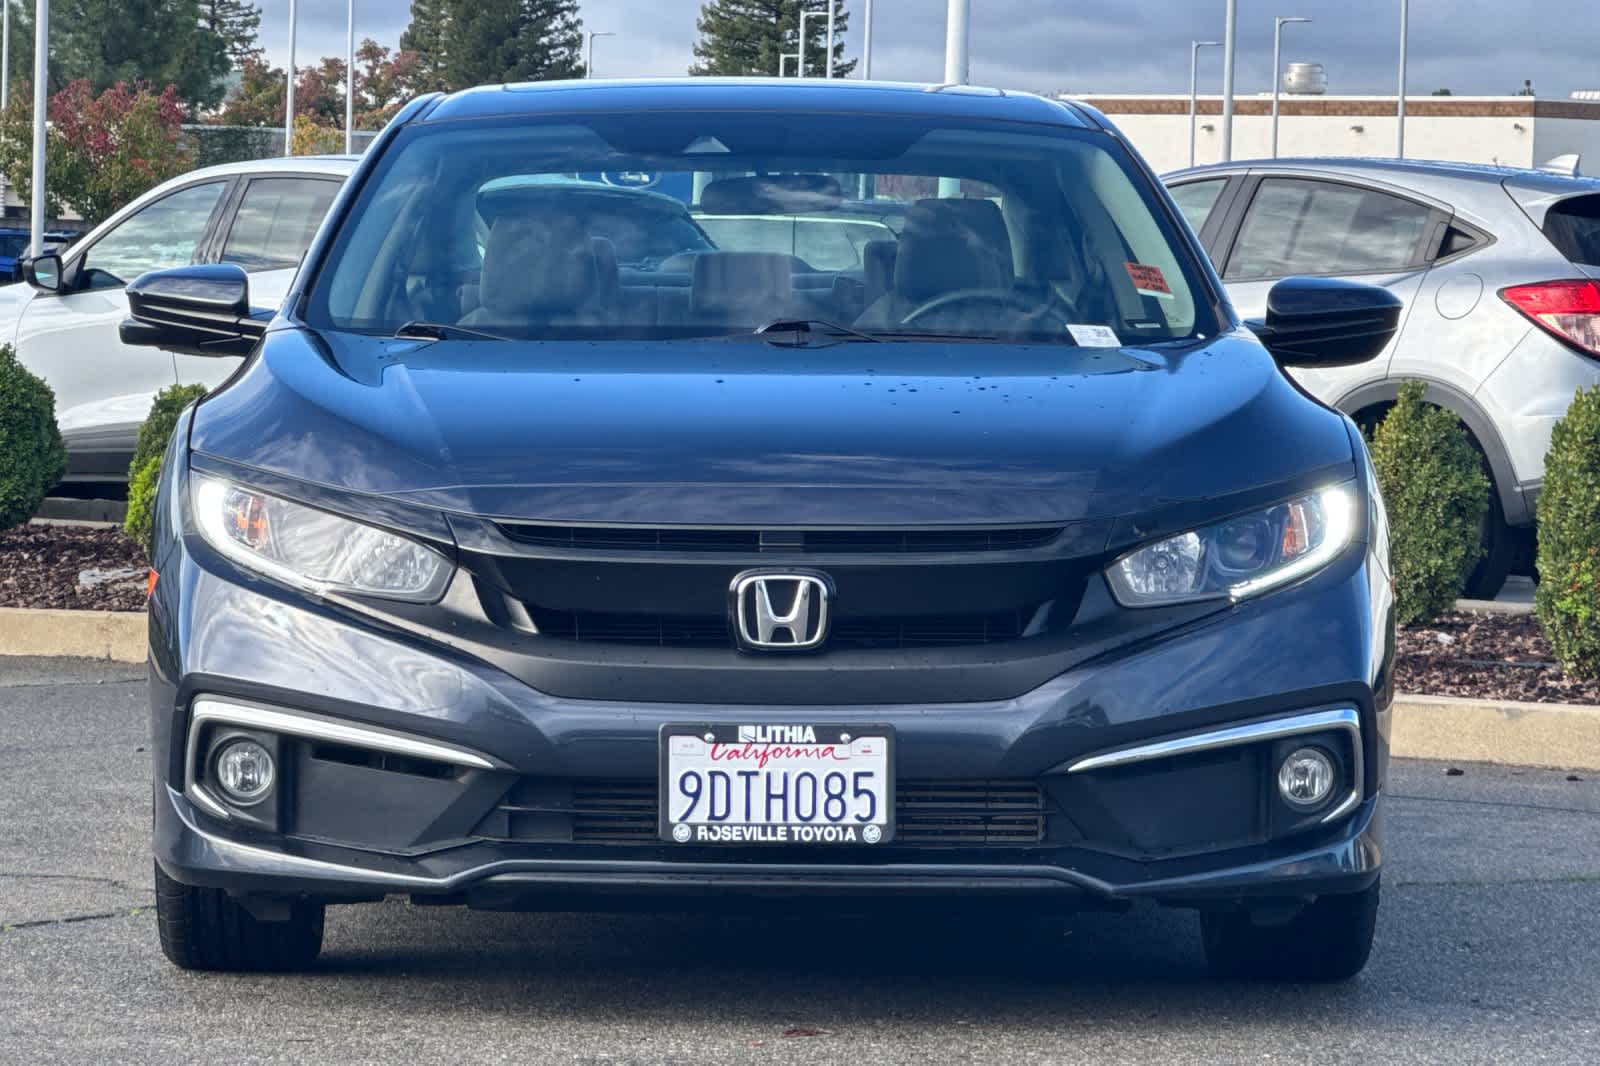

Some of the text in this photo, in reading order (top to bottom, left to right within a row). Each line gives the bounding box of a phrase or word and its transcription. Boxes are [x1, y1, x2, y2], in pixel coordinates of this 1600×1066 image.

[756, 726, 816, 743] LITHIA
[711, 743, 849, 768] California
[679, 770, 876, 822] 9DTH085
[697, 826, 787, 841] ROSEVILLE
